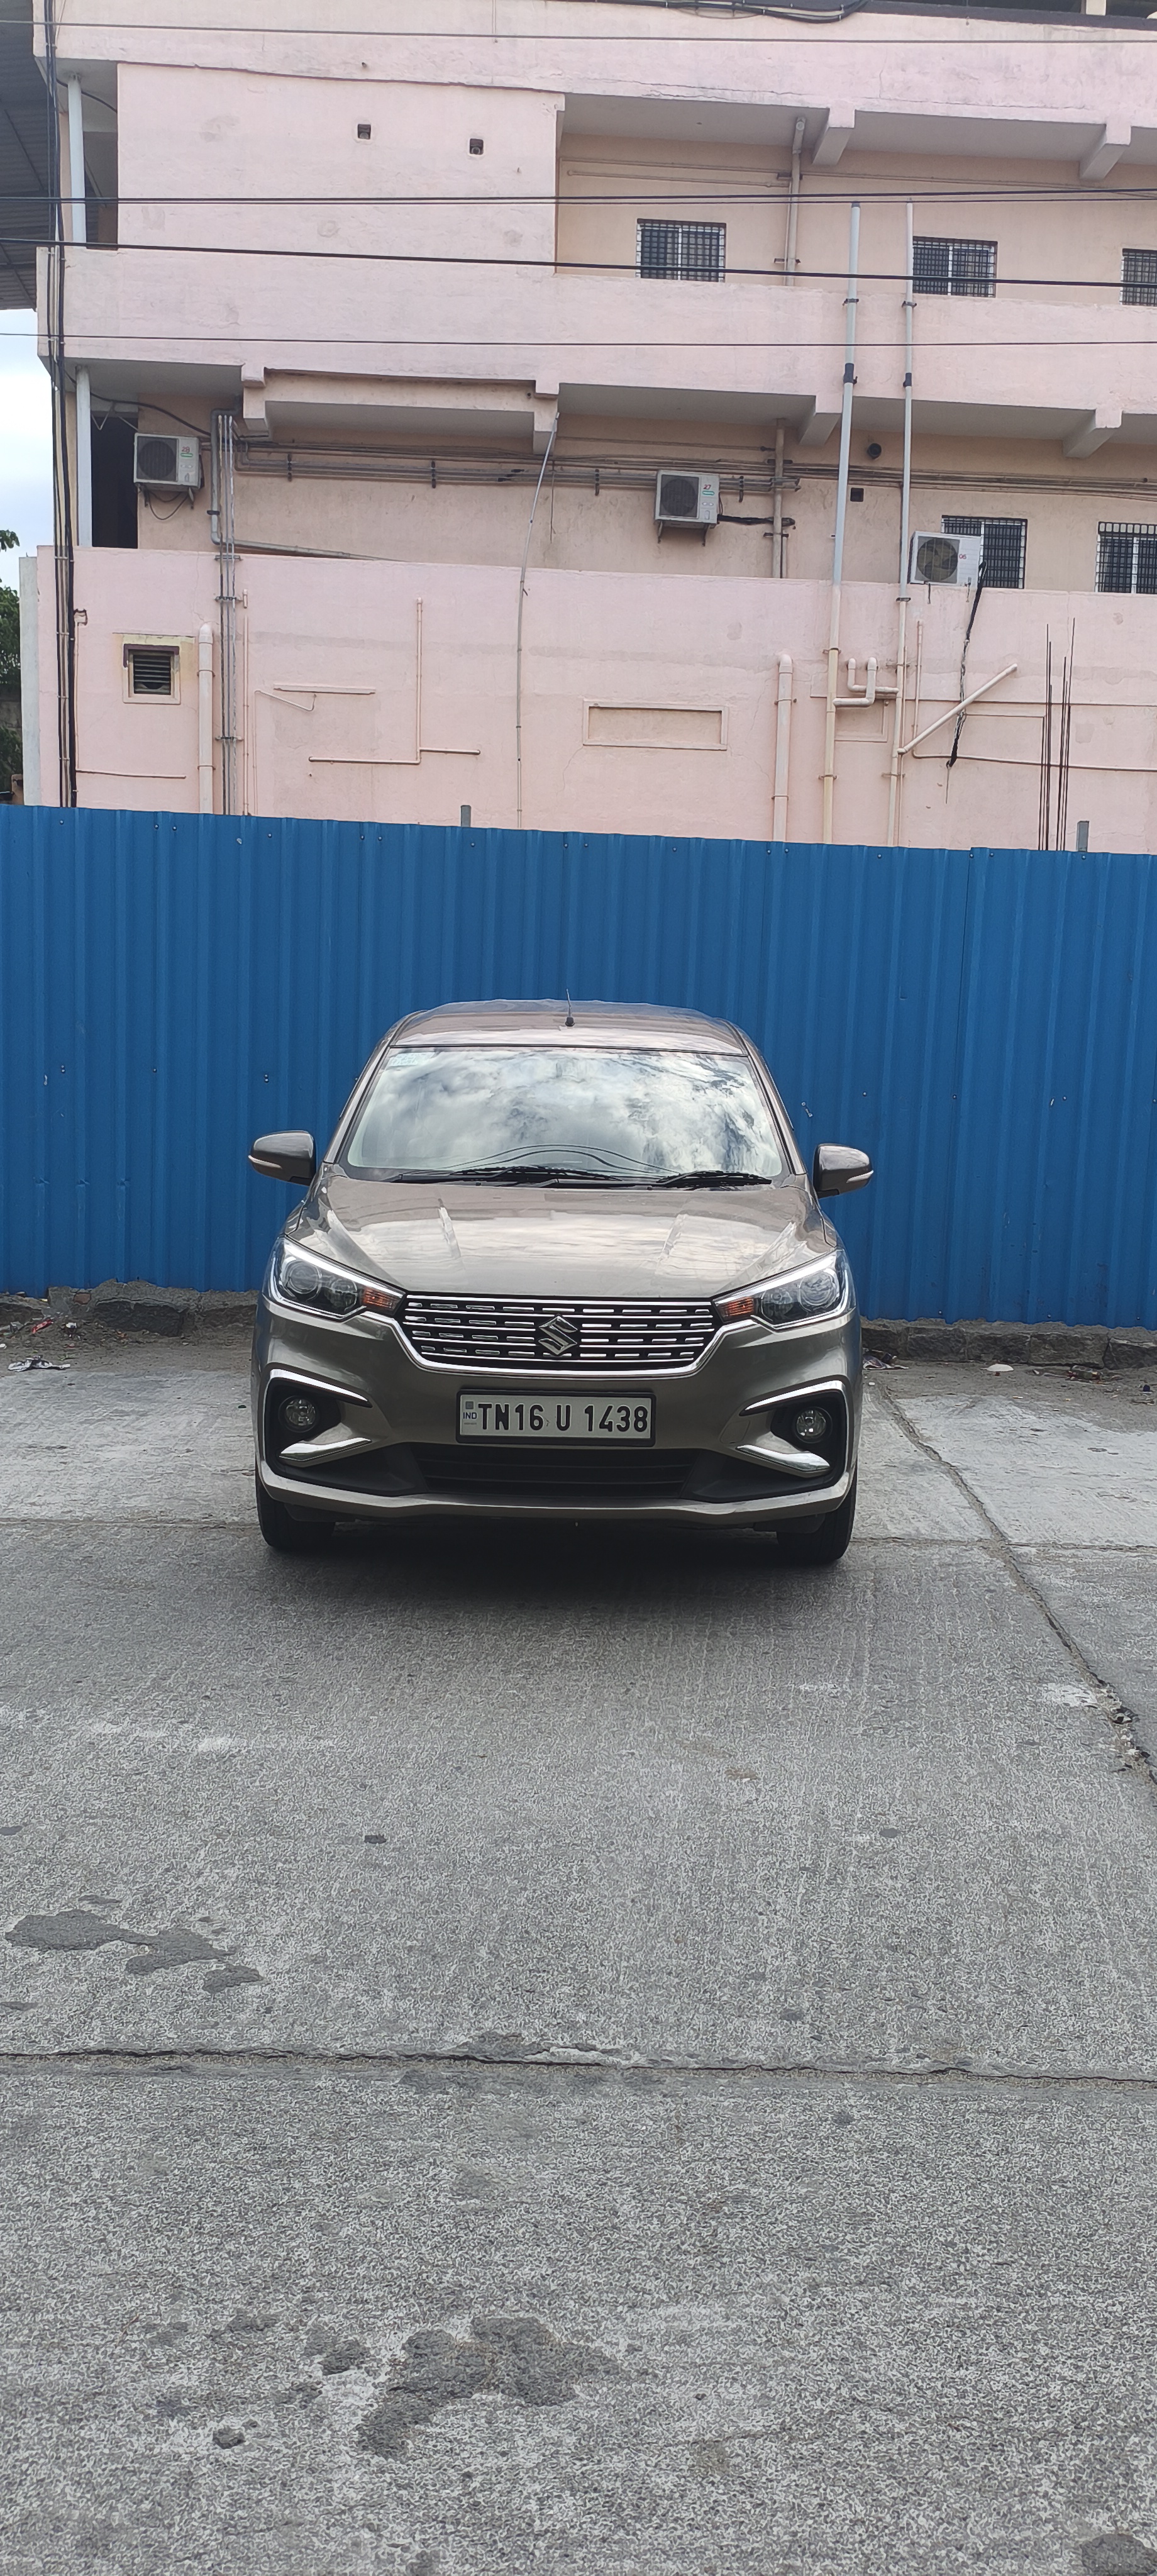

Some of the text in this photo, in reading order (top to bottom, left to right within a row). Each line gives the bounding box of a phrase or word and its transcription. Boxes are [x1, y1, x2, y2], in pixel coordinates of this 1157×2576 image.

[478, 1403, 648, 1433] TN16 U 1438
